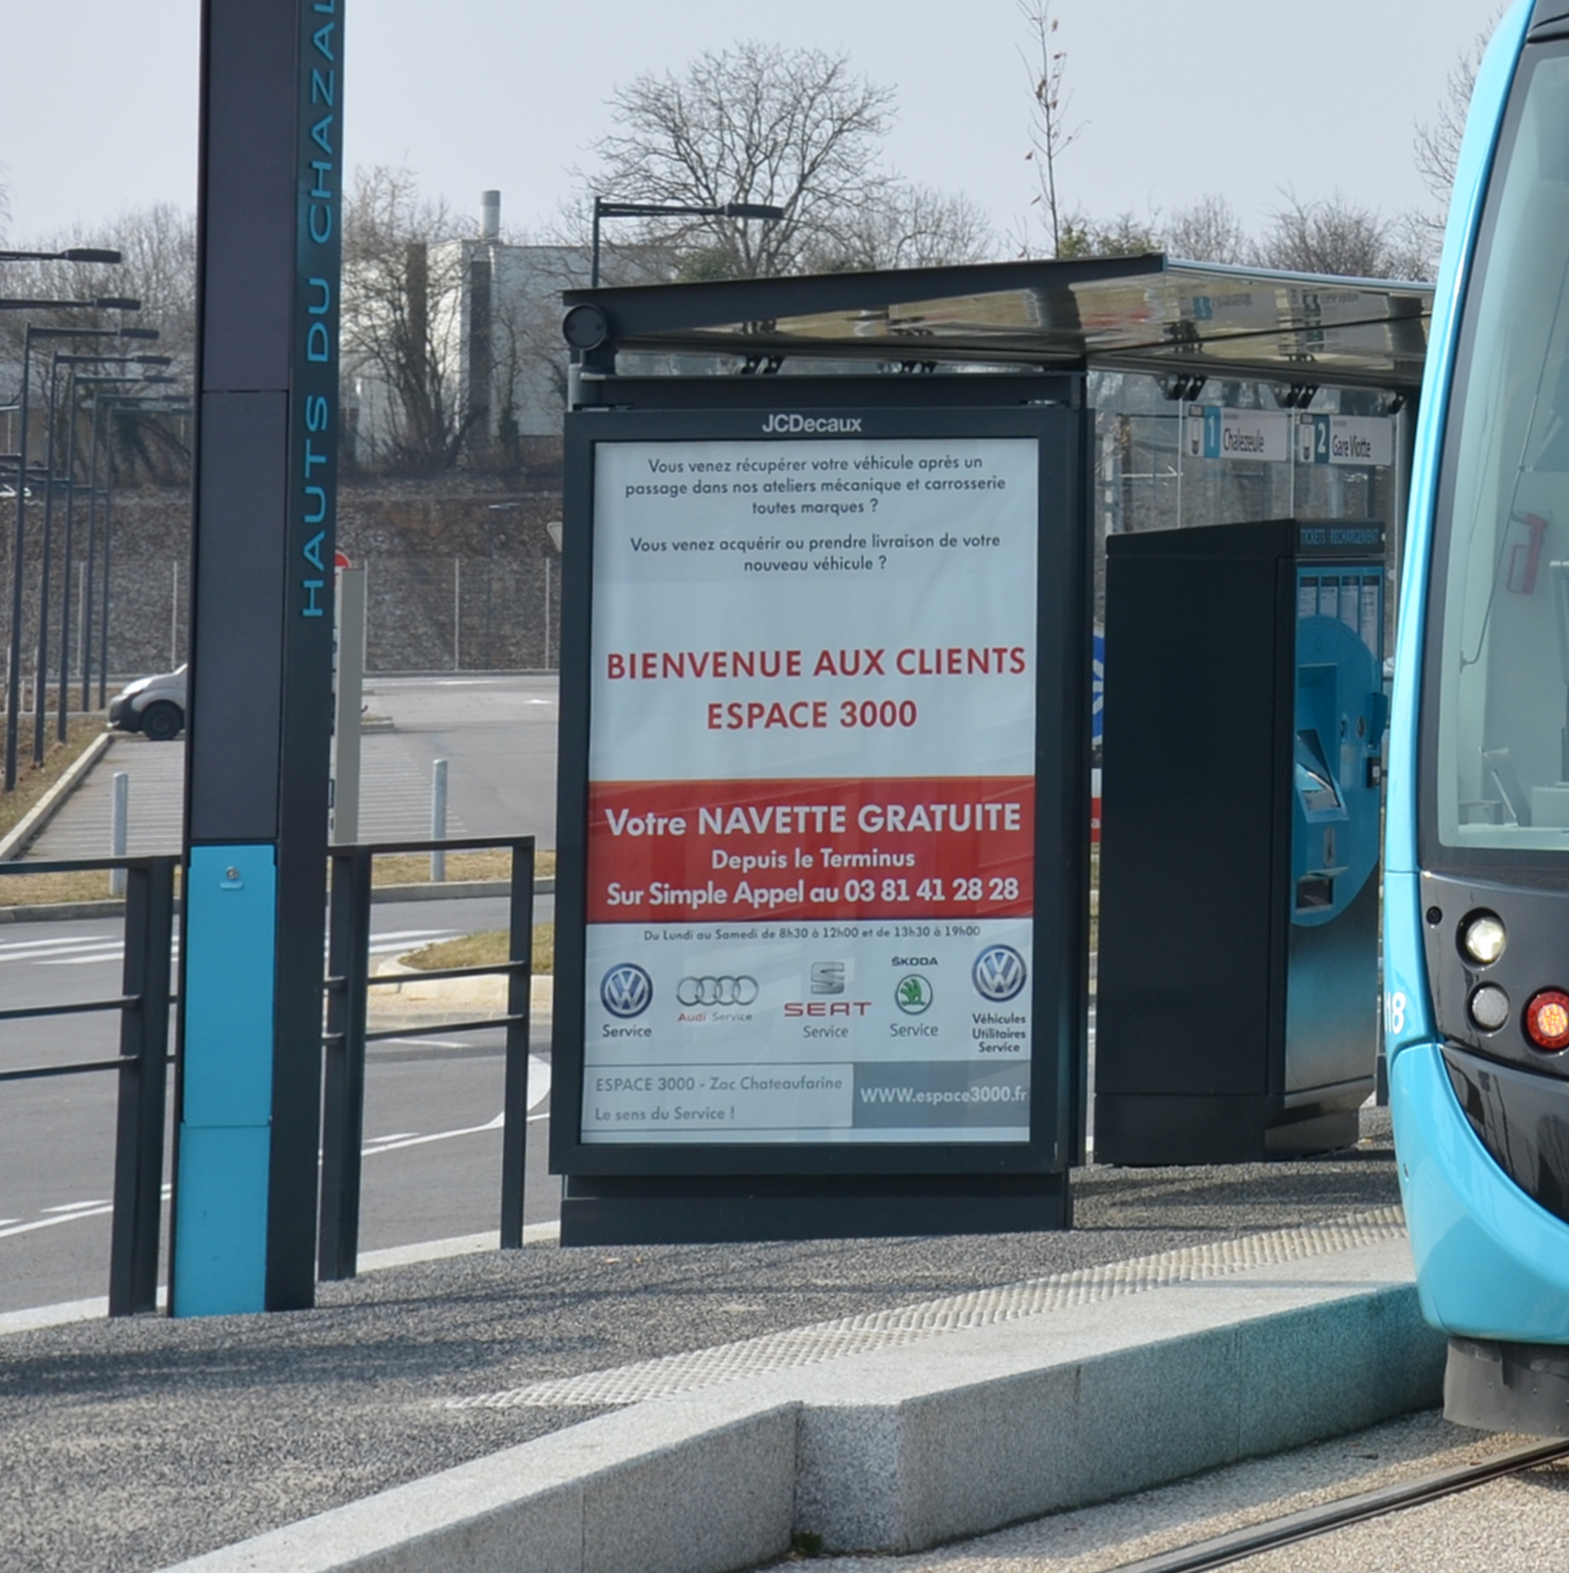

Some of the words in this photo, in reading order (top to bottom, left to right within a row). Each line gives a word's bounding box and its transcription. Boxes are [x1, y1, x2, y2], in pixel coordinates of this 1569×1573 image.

[306, 276, 332, 364] DU
[761, 414, 863, 434] JCDecaux
[1317, 422, 1326, 454] 2
[648, 458, 684, 473] Vous
[688, 461, 732, 473] venez
[736, 457, 807, 475] récupérer
[811, 457, 849, 471] votre
[853, 454, 914, 470] véhicule
[918, 454, 960, 472] après
[964, 457, 983, 469] un
[625, 483, 688, 499] passage
[692, 479, 728, 494] dans
[732, 482, 759, 494] nos
[763, 478, 816, 493] ateliers
[821, 477, 902, 494] mécanique
[906, 478, 920, 491] et
[924, 475, 1006, 491] carrosserie
[301, 393, 330, 618] HAUTS
[752, 501, 796, 514] toutes
[801, 501, 865, 517] marques
[869, 497, 879, 513] ?
[630, 537, 667, 552] Vous
[671, 539, 715, 551] venez
[719, 536, 781, 553] acquérir
[785, 538, 805, 551] ou
[809, 533, 867, 553] prendre
[871, 533, 935, 548] livraison
[939, 532, 958, 547] de
[962, 534, 1001, 547] votre
[744, 559, 809, 572] nouveau
[813, 555, 874, 571] véhicule
[878, 554, 888, 570] ?
[606, 649, 803, 680] BIENVENUE
[813, 648, 886, 677] AUX
[895, 646, 1027, 676] CLIENTS
[706, 701, 828, 730] ESPACE
[838, 699, 919, 728] 3000
[604, 807, 687, 837] Votre
[698, 805, 847, 835] NAVETTE
[857, 802, 1021, 833] GRATUITE
[711, 849, 788, 874] Depuis
[795, 847, 814, 868] le
[819, 847, 916, 868] Terminus
[606, 882, 645, 906] Sur
[649, 879, 728, 910] Simple
[733, 878, 804, 909] Appel
[809, 885, 839, 903] au
[844, 878, 876, 903] 03
[880, 878, 910, 902] 81
[916, 878, 946, 902] 41
[952, 877, 984, 902] 28
[988, 877, 1020, 902] 28
[643, 930, 660, 941] Du
[662, 929, 694, 940] Lundi
[698, 931, 712, 940] au
[715, 928, 758, 940] Samedi
[761, 928, 776, 940] de
[778, 927, 808, 939] 8h30
[823, 926, 859, 939] 12h00
[862, 927, 873, 938] et
[876, 927, 891, 938] de
[894, 926, 930, 938] 13h30
[945, 925, 981, 937] 19h00
[891, 956, 939, 967] ŠKODA
[677, 1012, 707, 1023] Audi
[711, 1012, 754, 1023] Service
[783, 1001, 873, 1018] SEAT
[971, 1012, 1027, 1025] Véhicules
[601, 1024, 653, 1039] Service
[802, 1024, 850, 1040] Service
[889, 1023, 939, 1038] Service
[971, 1028, 1027, 1040] Utilitaires
[978, 1041, 1021, 1054] Service
[595, 1077, 653, 1093] ESPACE
[657, 1076, 696, 1092] 3000
[709, 1076, 737, 1091] Zac
[739, 1074, 844, 1091] Chateaufarine
[859, 1084, 1028, 1106] WWW.espace3000.fr
[594, 1107, 611, 1121] Le
[615, 1109, 647, 1121] sens
[650, 1105, 670, 1121] du
[673, 1105, 726, 1121] Service
[729, 1105, 736, 1120] !
